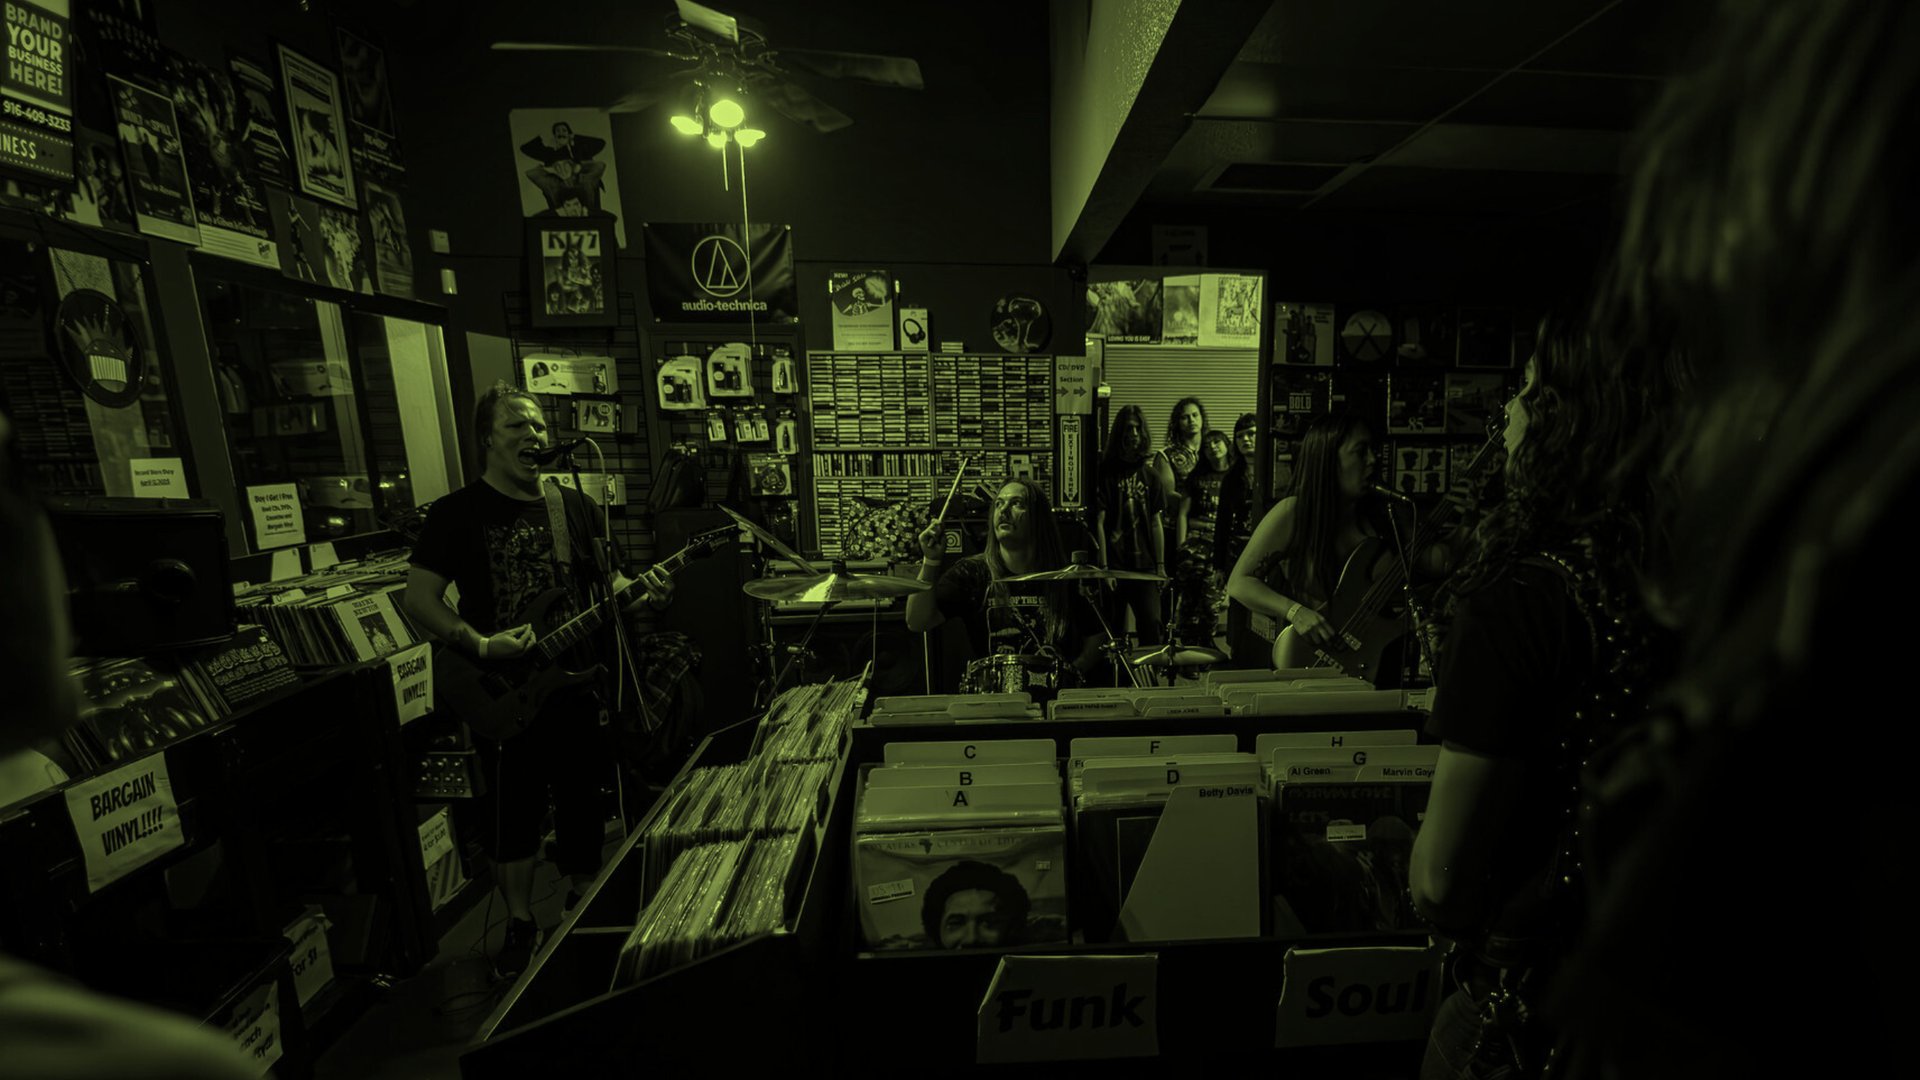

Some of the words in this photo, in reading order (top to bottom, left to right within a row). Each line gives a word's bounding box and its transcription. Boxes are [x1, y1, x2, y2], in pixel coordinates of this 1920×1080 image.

[5, 2, 63, 40] BRAND
[6, 22, 63, 63] YOUR
[8, 45, 63, 76] BUSINESS
[9, 60, 63, 96] HERE!
[3, 100, 71, 132] 916-409-3233
[681, 299, 768, 312] audio-technica
[1063, 424, 1079, 433] FIRE
[397, 655, 427, 681] BARGAIN
[1150, 740, 1161, 754] F
[1331, 736, 1343, 747] H
[963, 745, 976, 759] C
[1353, 751, 1366, 765] G
[959, 771, 973, 786] B
[1166, 769, 1180, 784] D
[1291, 767, 1301, 776] Al
[1303, 767, 1331, 775] Green
[1382, 767, 1413, 776] Marvin
[90, 771, 156, 822] BARGAIN
[953, 790, 969, 807] A
[1199, 788, 1224, 798] Betty
[1227, 786, 1253, 795] Davis
[102, 806, 163, 856] VINYL!!!!
[1306, 969, 1430, 1019] Soul
[996, 983, 1147, 1033] Funk
